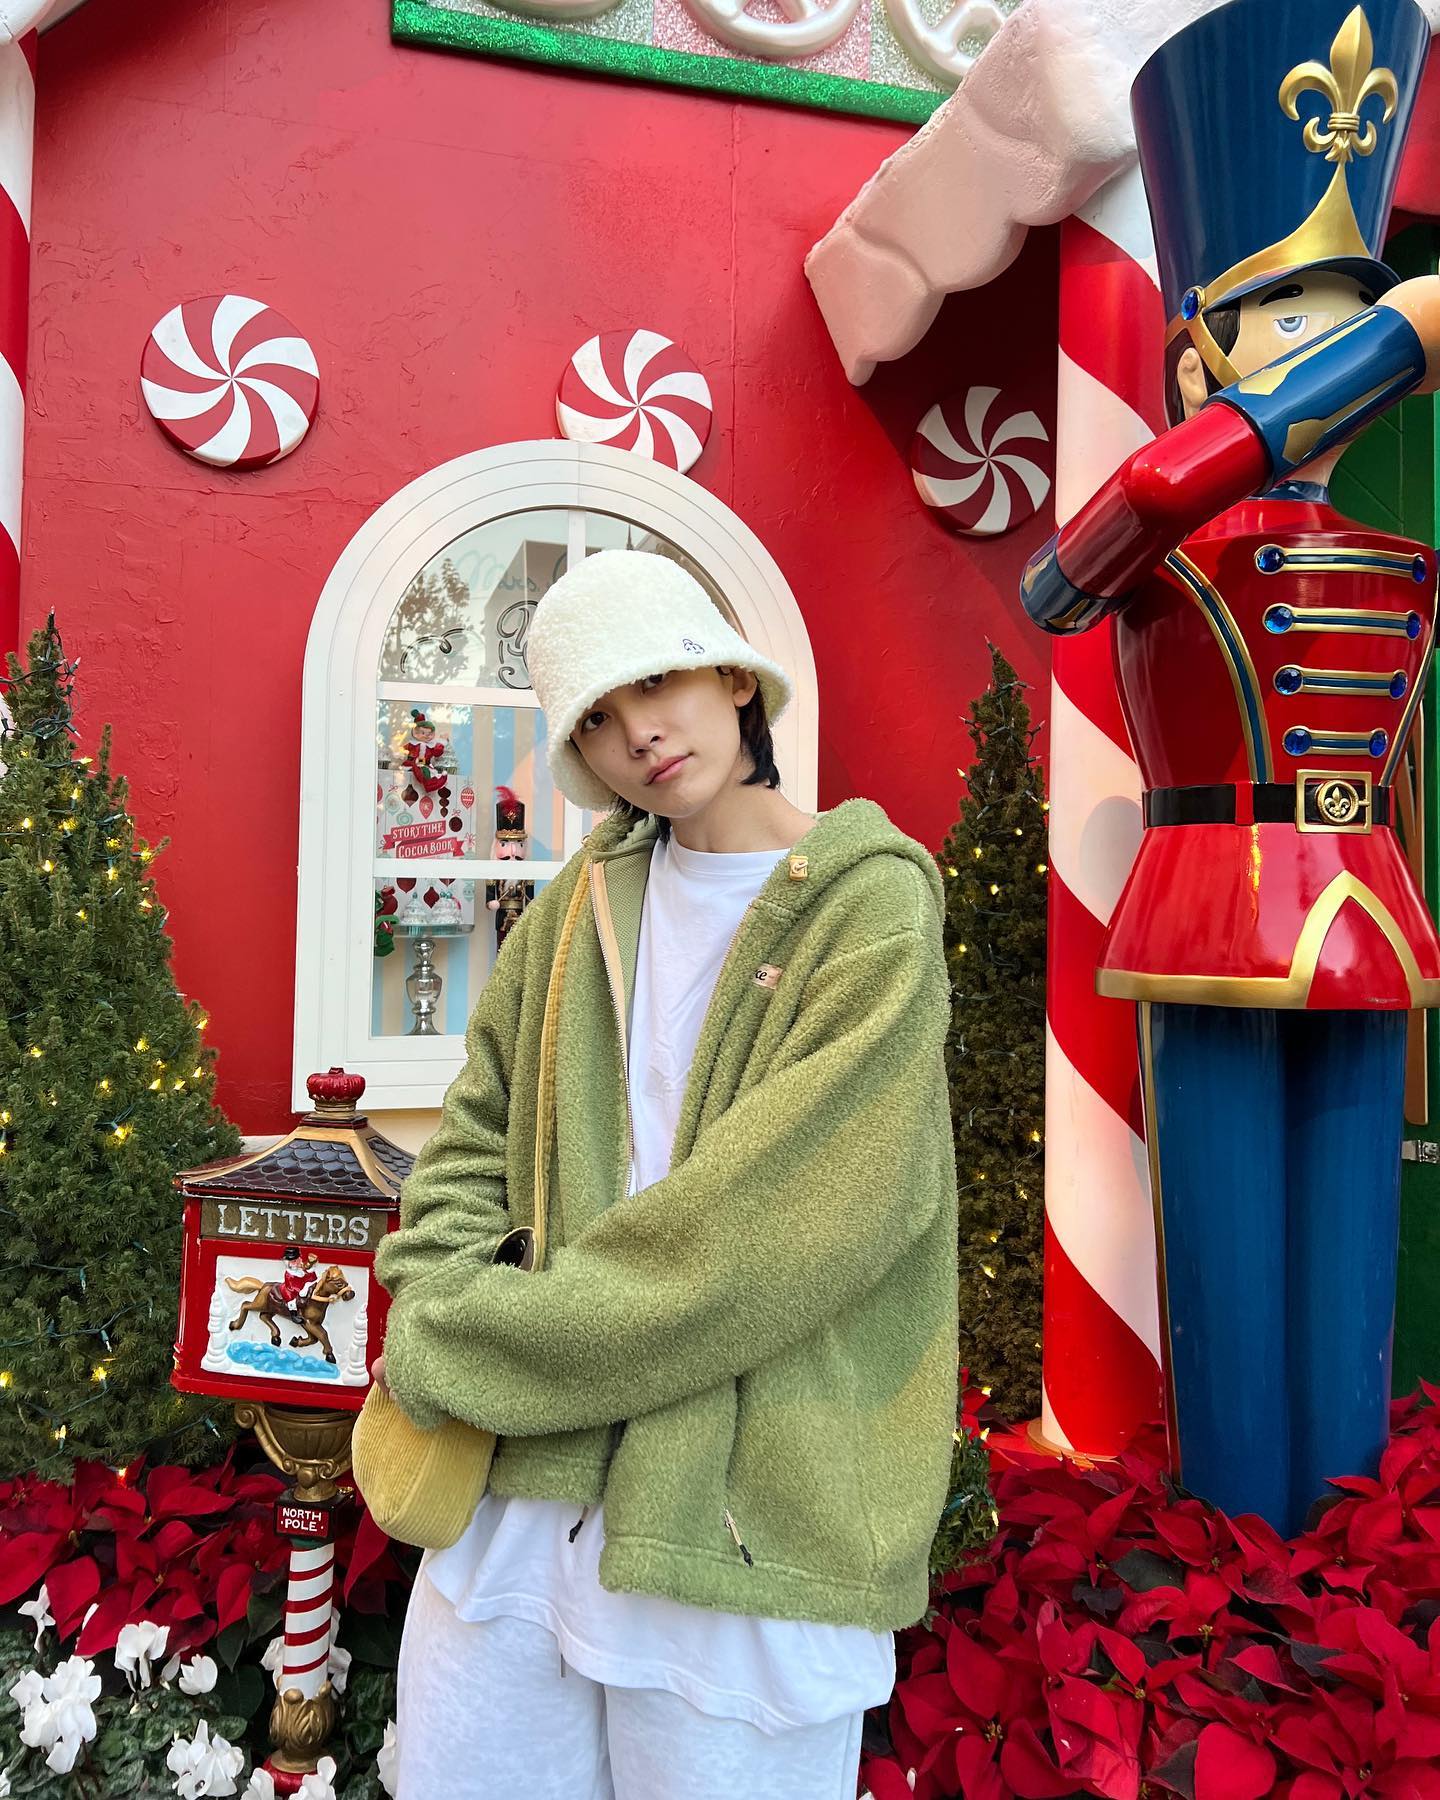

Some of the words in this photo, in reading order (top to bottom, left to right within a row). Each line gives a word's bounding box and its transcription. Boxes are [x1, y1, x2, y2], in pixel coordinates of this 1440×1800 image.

[398, 843, 429, 858] COCOA
[429, 840, 455, 854] BOOK
[217, 1204, 370, 1246] LETTERS
[282, 1507, 322, 1521] NORTH
